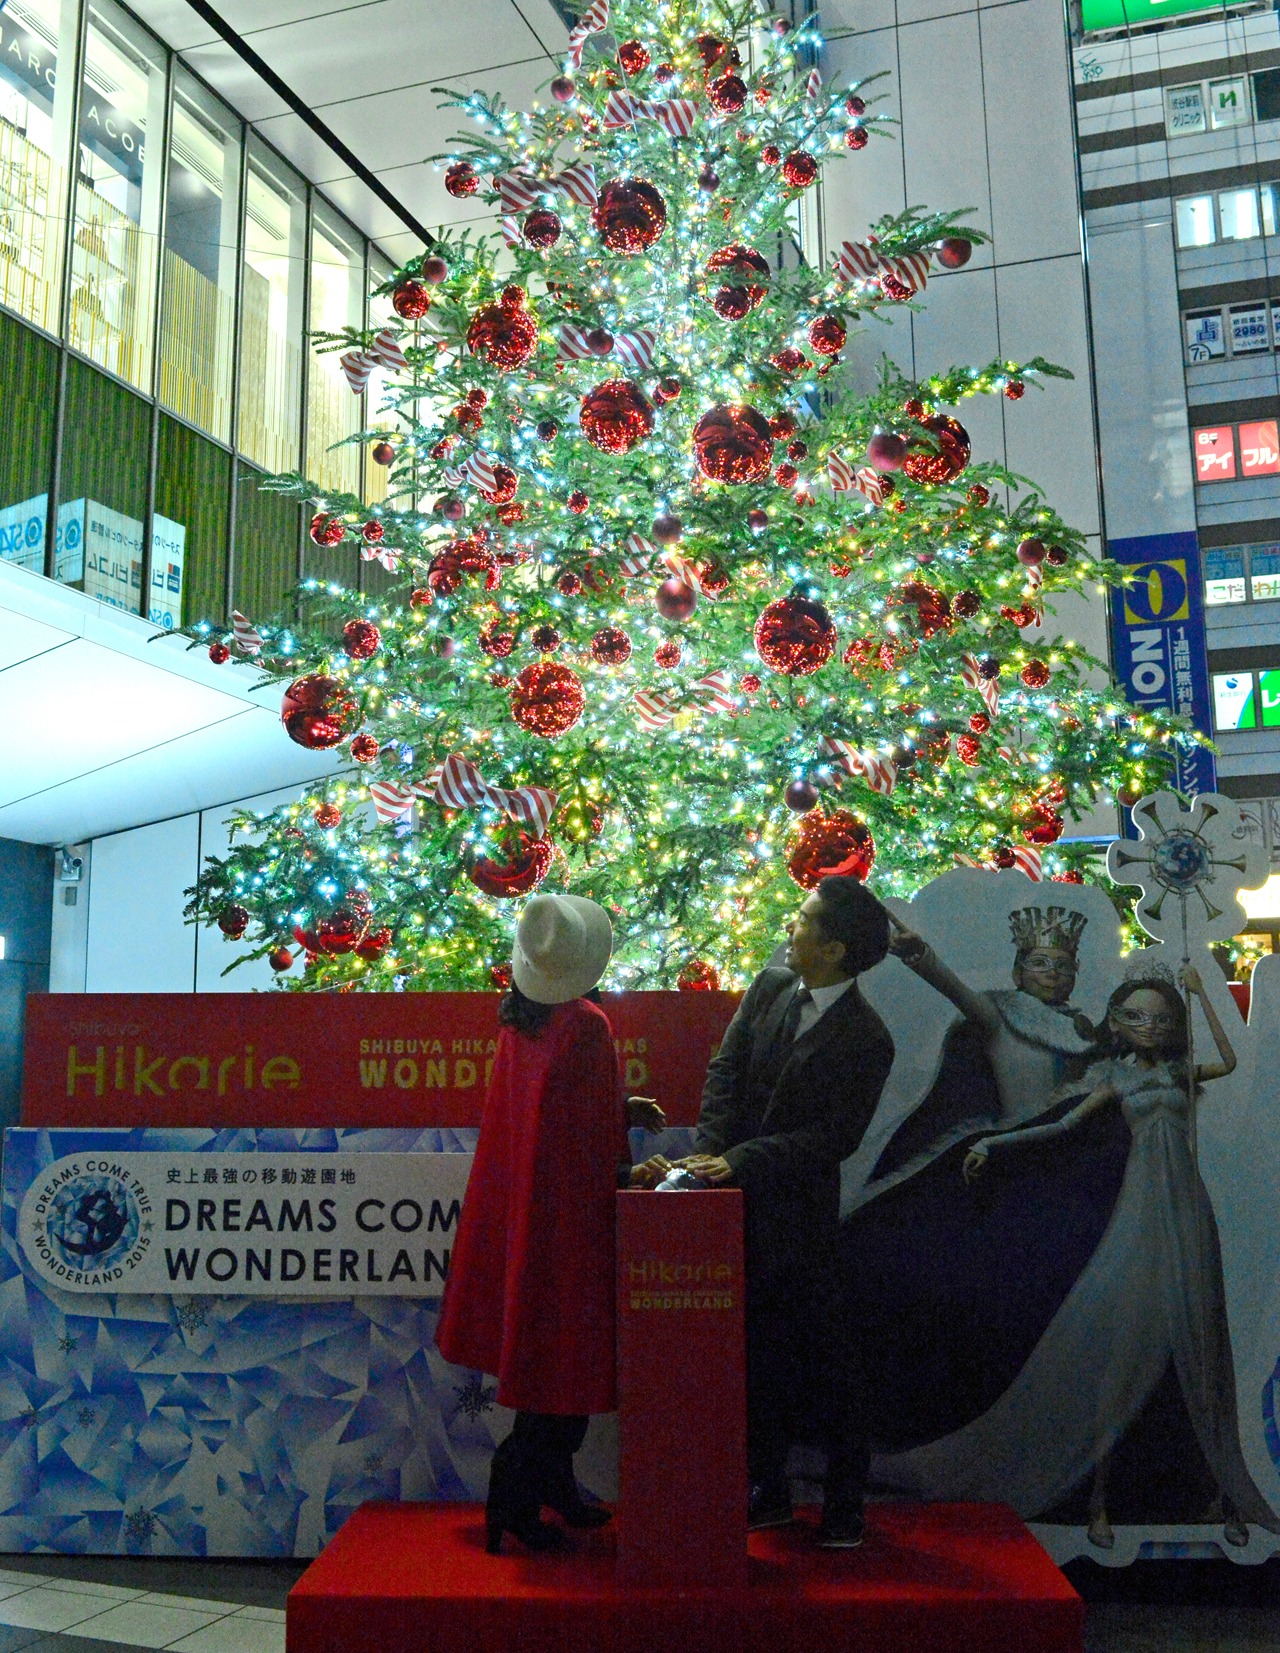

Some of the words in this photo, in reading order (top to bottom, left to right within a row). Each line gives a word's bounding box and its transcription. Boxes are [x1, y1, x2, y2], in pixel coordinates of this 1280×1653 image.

[1172, 112, 1201, 128] クリニック
[88, 105, 145, 164] ACOB
[1191, 347, 1207, 361] 7F
[359, 1039, 443, 1055] SHIBUYA
[451, 1039, 497, 1055] HIKA
[66, 1044, 302, 1097] Hikarie
[35, 1164, 81, 1214] DREAMS
[86, 1160, 131, 1182] COME
[130, 1179, 152, 1214] TRUE
[166, 1168, 357, 1185] 史上最強の移動遊園地
[165, 1199, 337, 1233] DREAMS
[355, 1198, 463, 1233] COM
[35, 1235, 123, 1285] WONDERLAND
[126, 1236, 151, 1270] 2015
[164, 1248, 450, 1282] WONDERLAN
[629, 1261, 733, 1284] Hikarie
[630, 1297, 733, 1310] WONDERLAND
